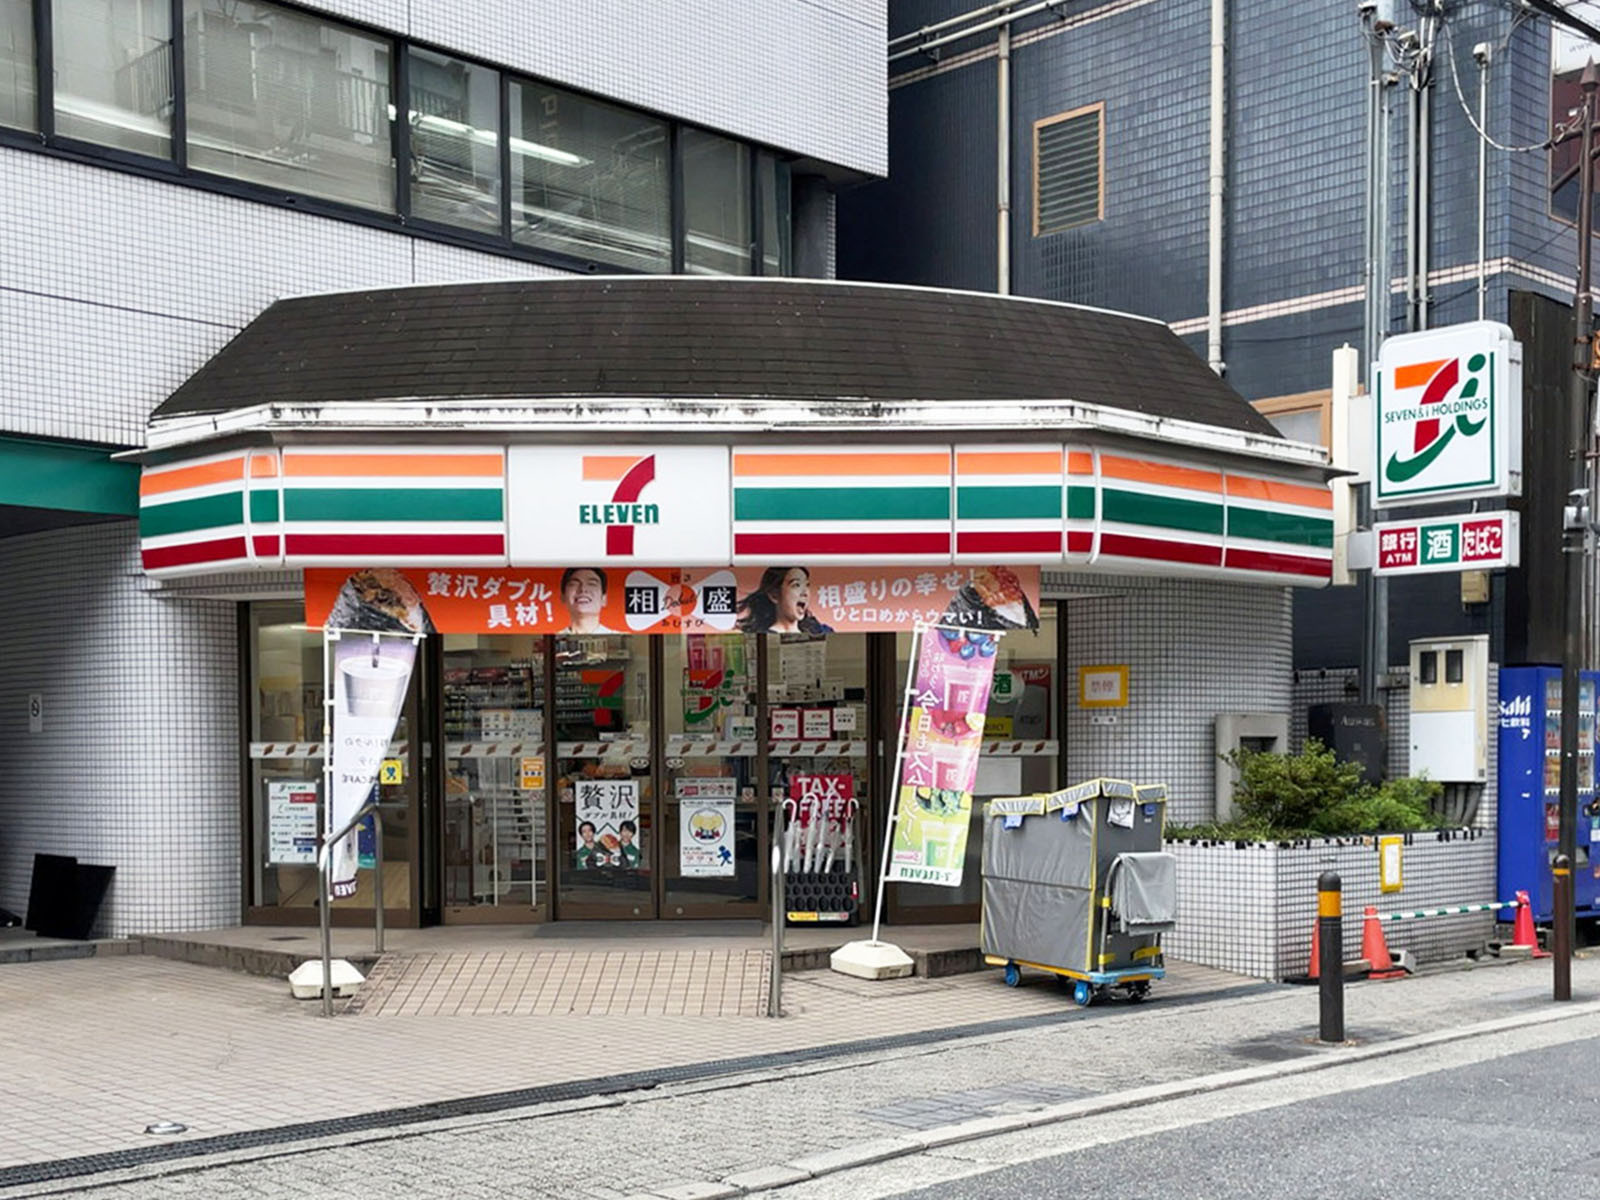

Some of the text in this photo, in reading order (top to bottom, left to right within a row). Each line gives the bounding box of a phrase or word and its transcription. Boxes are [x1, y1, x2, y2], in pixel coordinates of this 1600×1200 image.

[1433, 397, 1488, 416] HOLDINGS
[1382, 532, 1417, 552] 銀行
[1427, 529, 1454, 560] 酒
[1462, 525, 1502, 558] たばこ
[1386, 552, 1412, 565] ATM
[427, 571, 553, 602] 贅沢ダブル
[628, 587, 732, 613] 相 盛
[487, 601, 554, 629] 具材!
[993, 673, 1012, 695] 酒
[580, 783, 635, 811] 贅沢
[797, 777, 846, 797] TAX-
